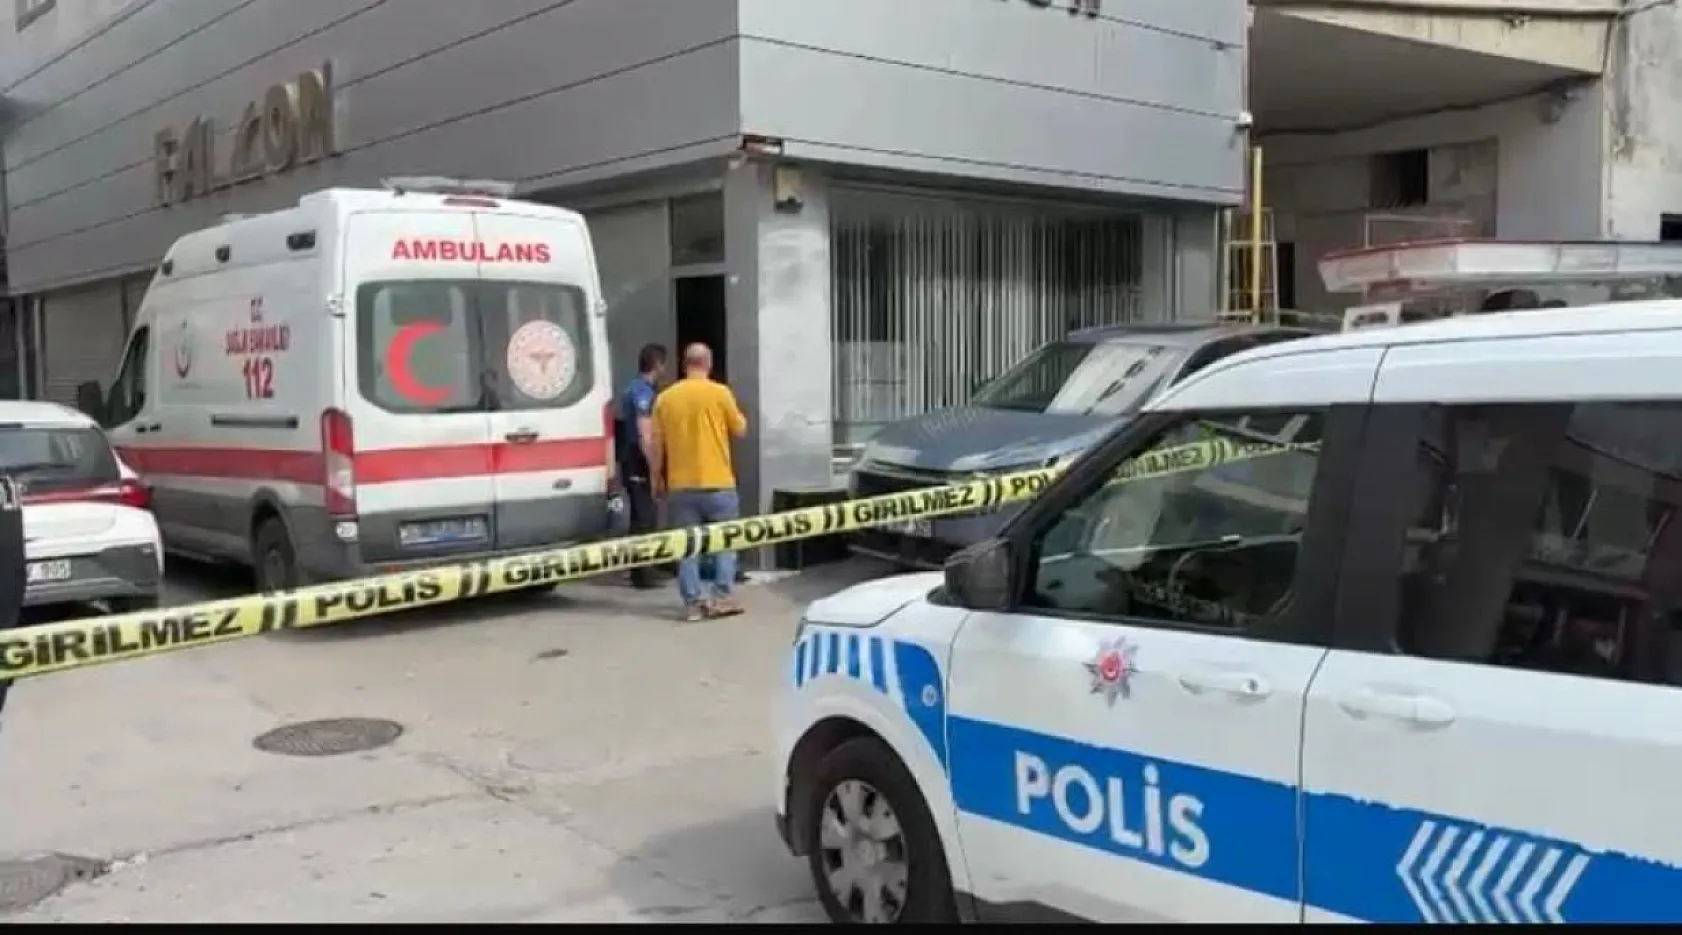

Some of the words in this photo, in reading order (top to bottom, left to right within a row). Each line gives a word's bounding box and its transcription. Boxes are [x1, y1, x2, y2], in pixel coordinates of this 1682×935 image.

[391, 239, 551, 264] AMBULANS
[243, 356, 275, 400] 112
[1014, 751, 1210, 869] POLİS
